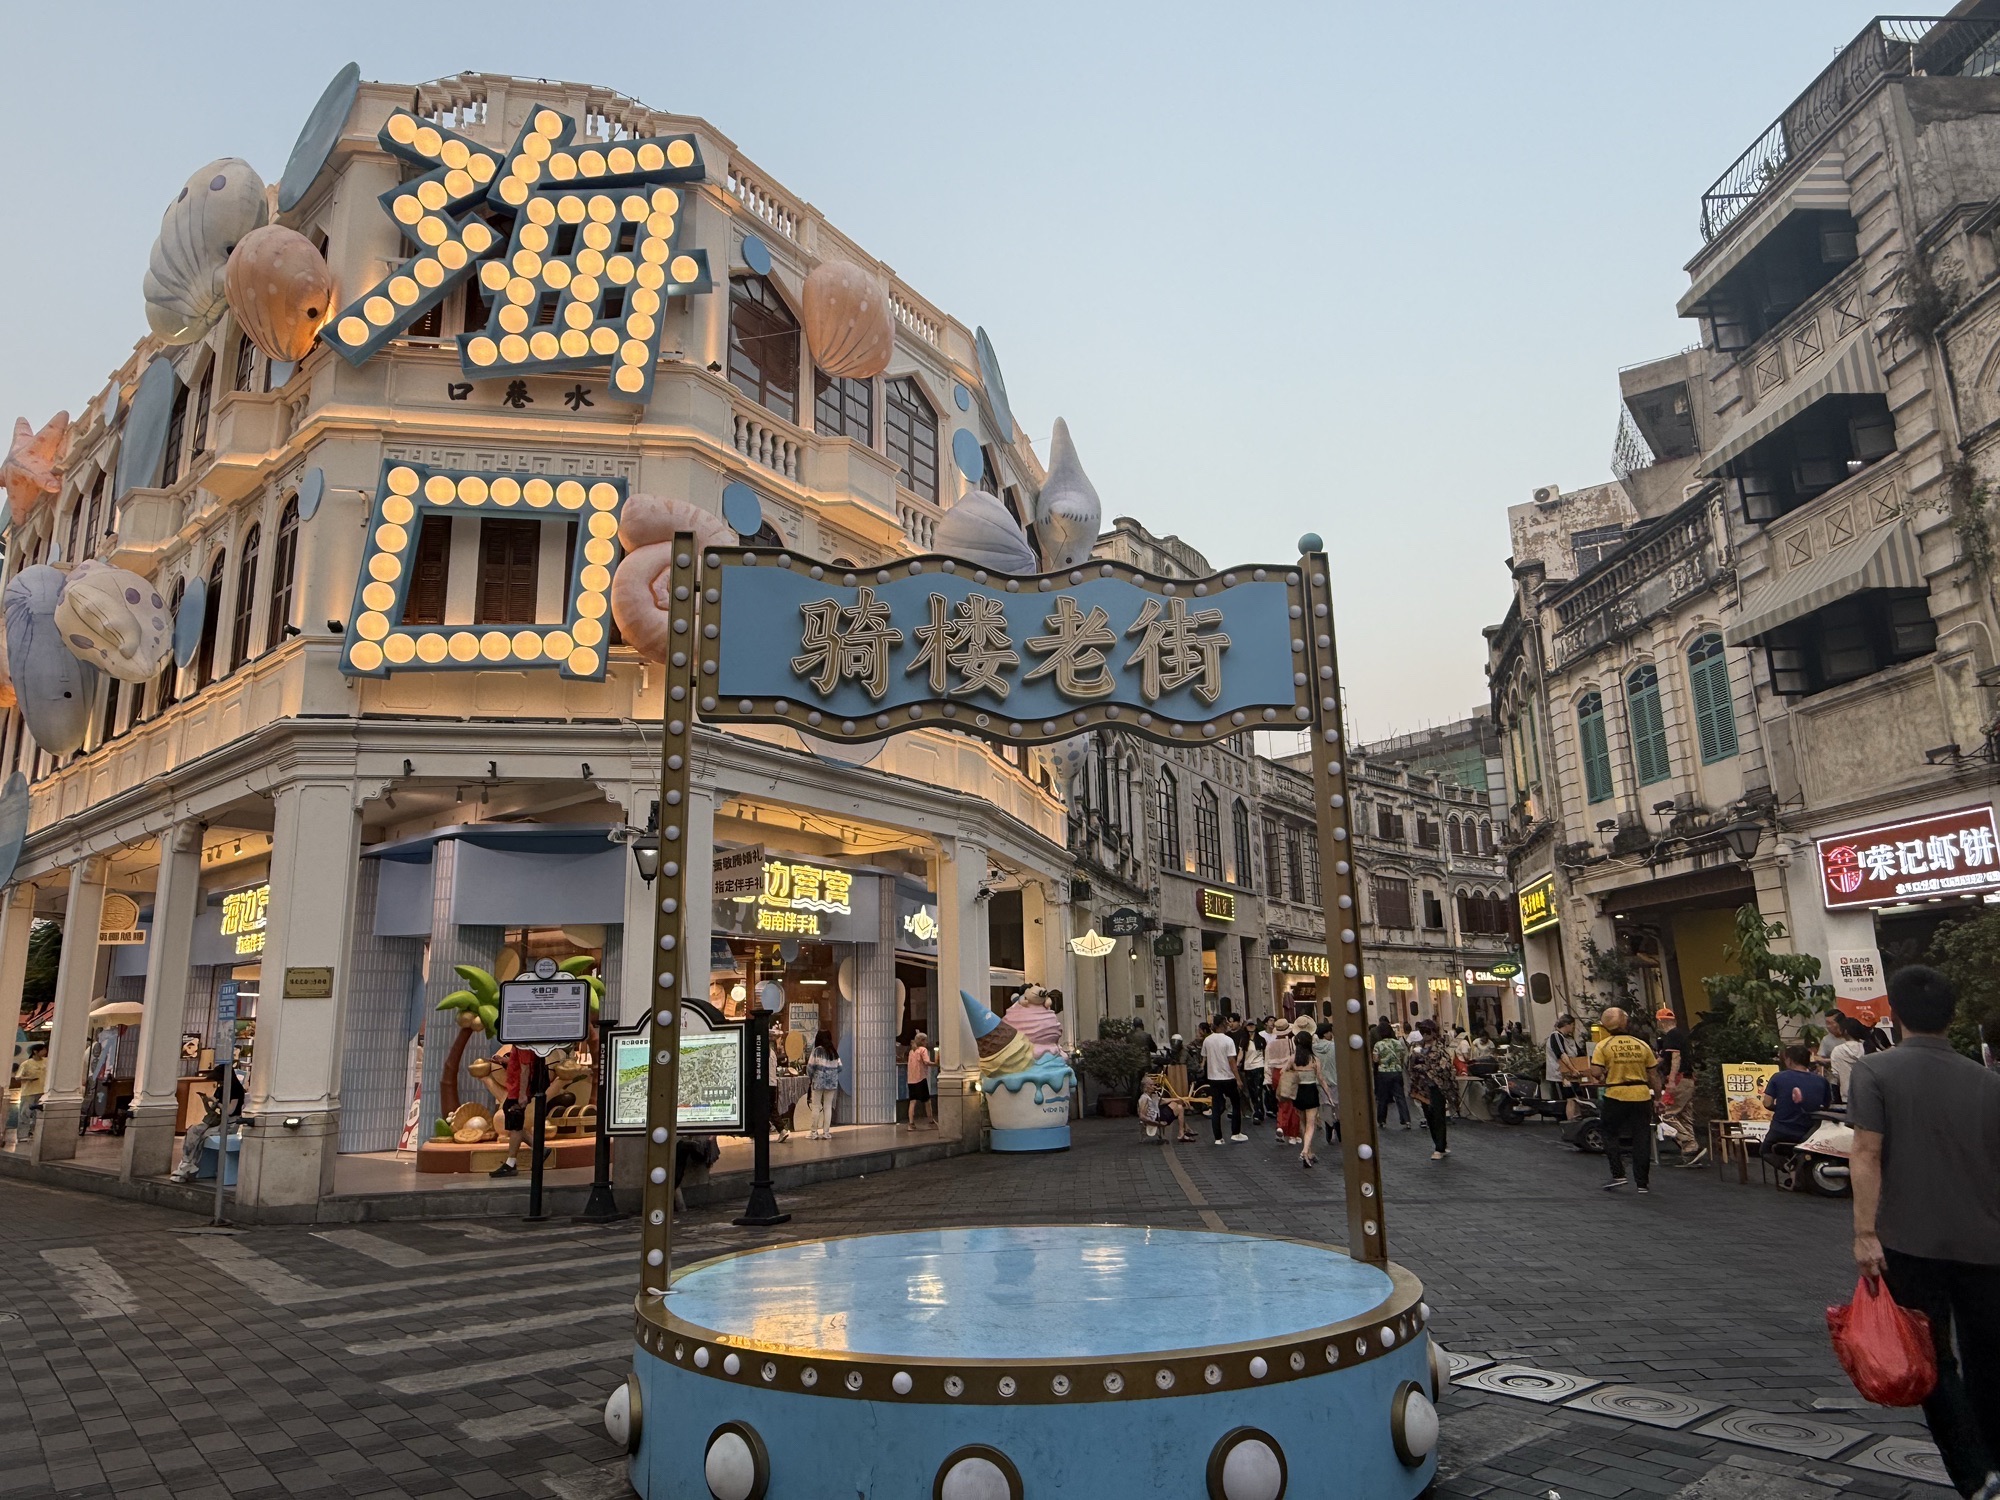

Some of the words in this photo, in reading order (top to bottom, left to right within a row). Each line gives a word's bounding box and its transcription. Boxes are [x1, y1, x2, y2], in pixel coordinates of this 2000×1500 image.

[320, 103, 711, 405] 海
[790, 587, 1232, 704] 骑楼老街
[1865, 826, 1995, 880] 荣记虾饼
[715, 877, 763, 893] 指定伴手礼
[757, 909, 820, 934] 海南伴手礼
[1840, 963, 1875, 978] 销量榜
